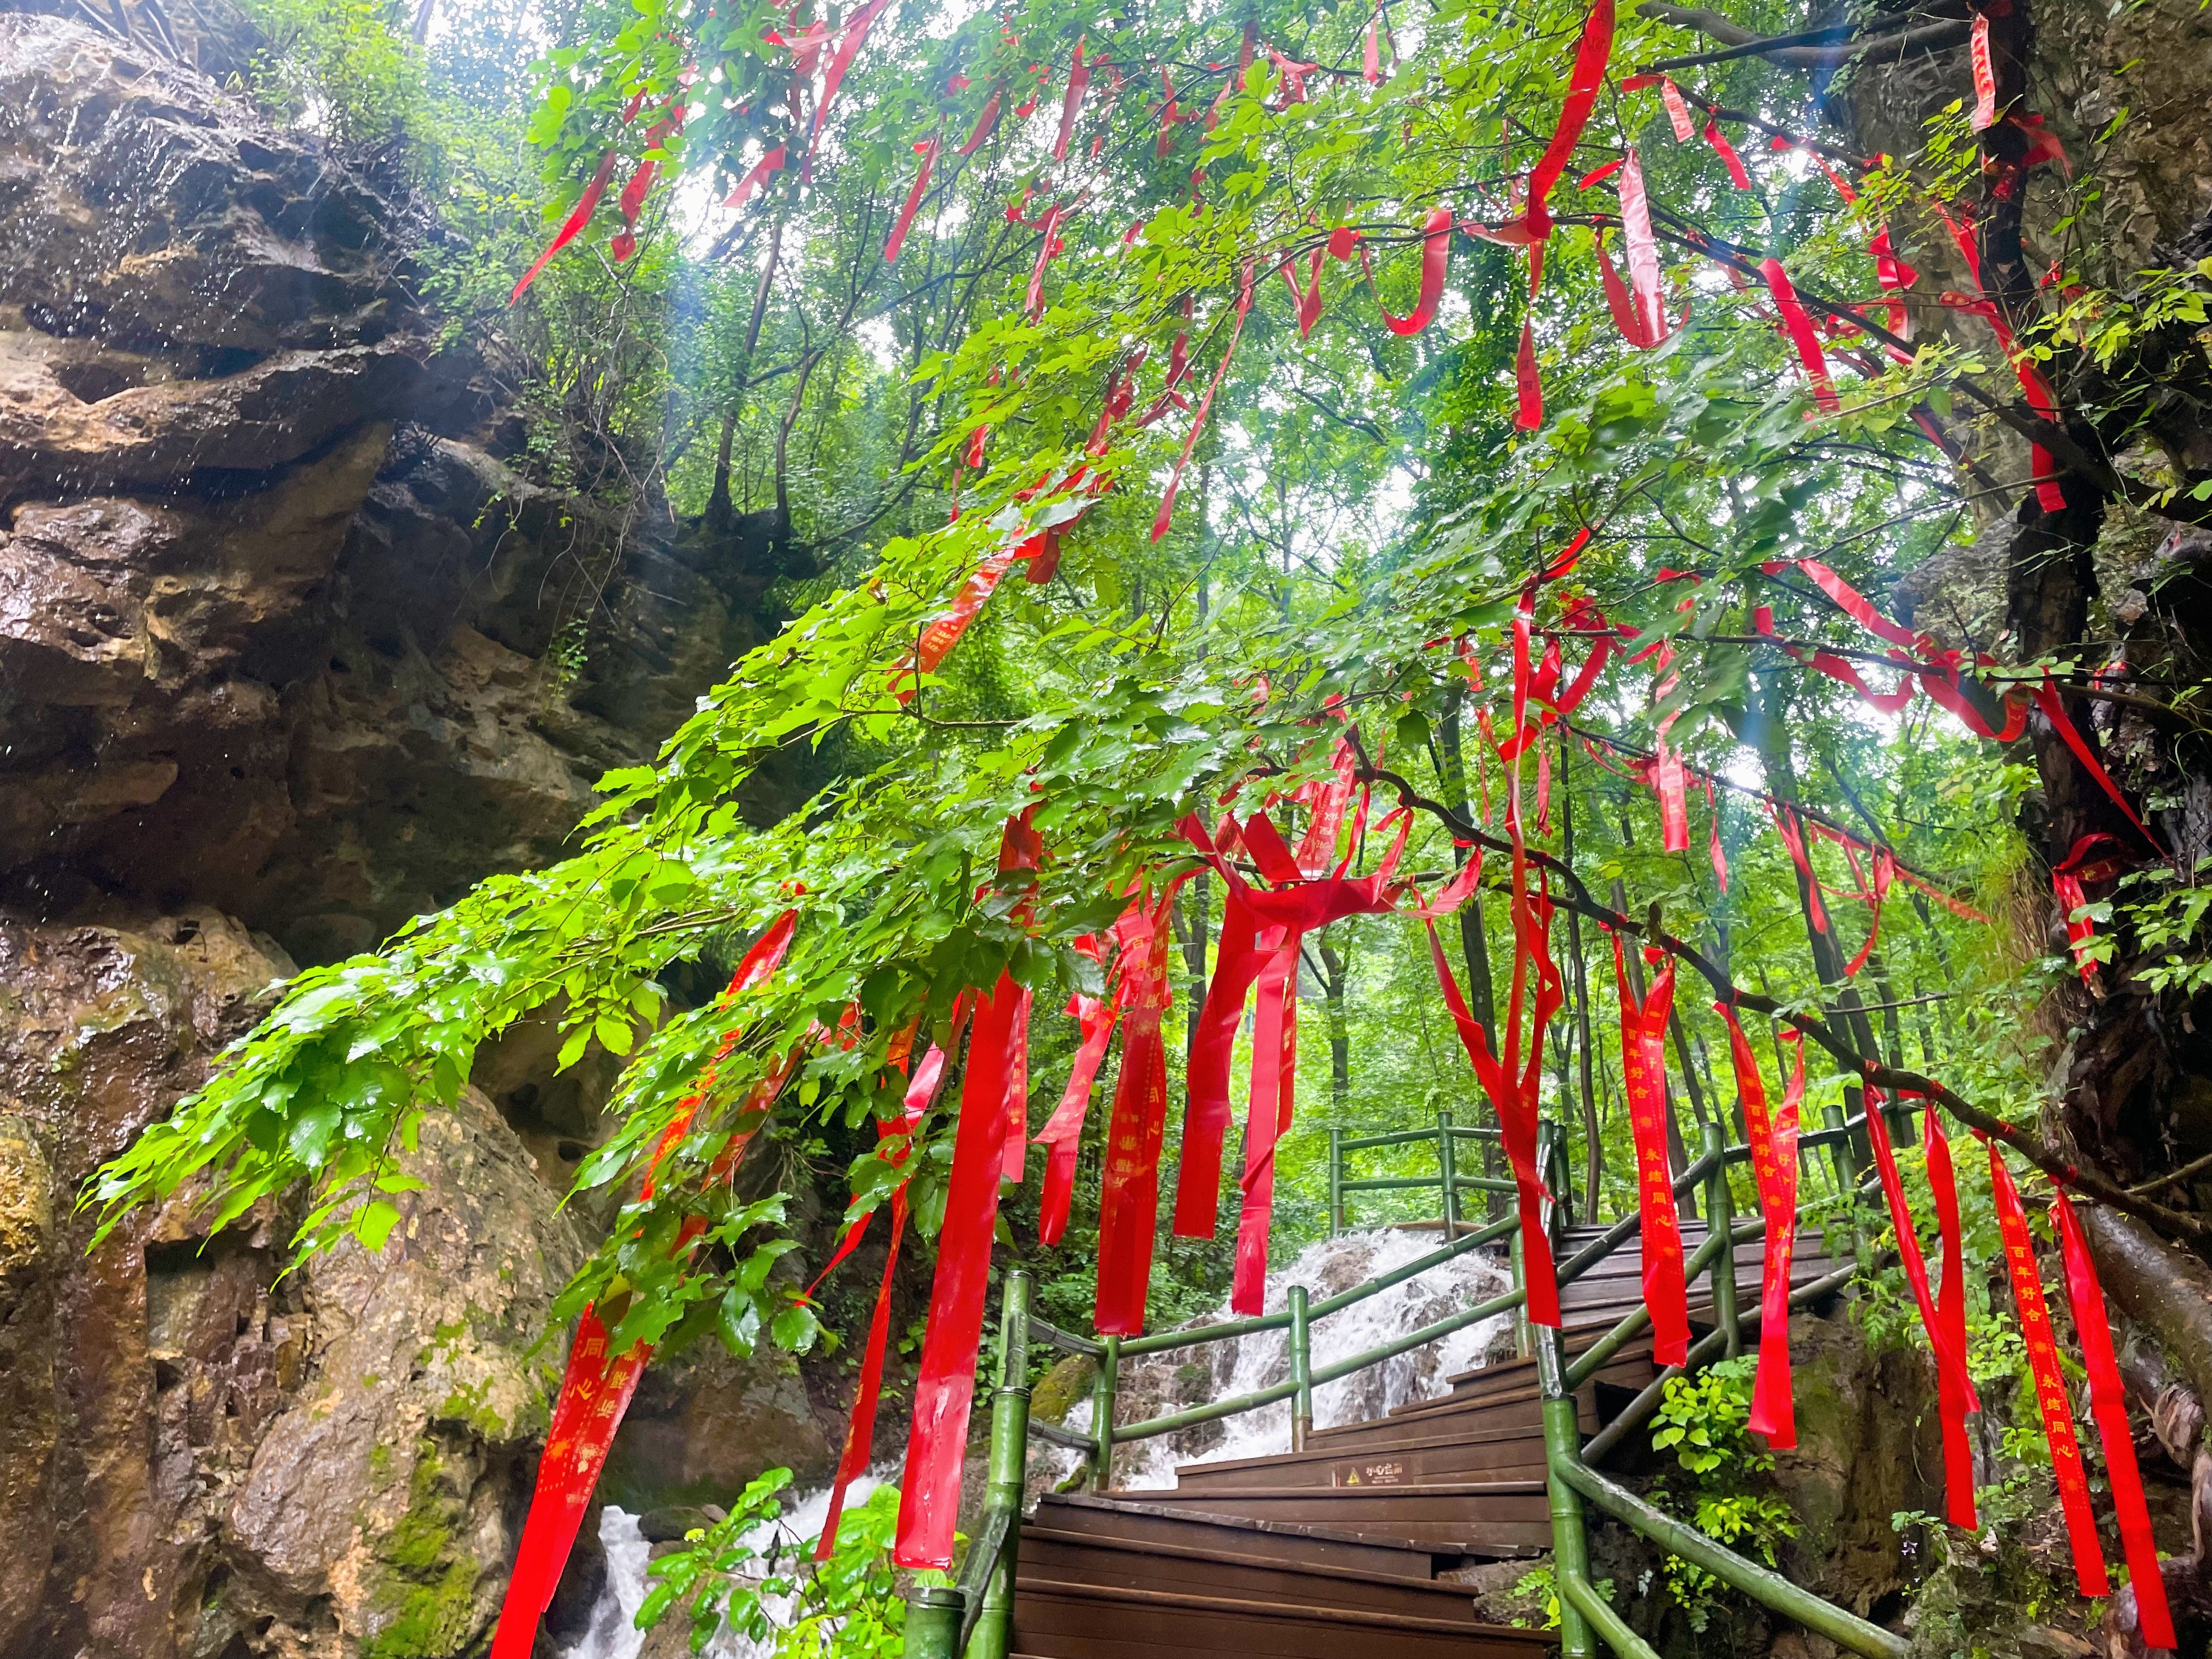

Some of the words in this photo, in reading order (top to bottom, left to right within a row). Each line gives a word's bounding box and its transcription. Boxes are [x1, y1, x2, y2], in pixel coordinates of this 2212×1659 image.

[1627, 1028, 1649, 1099] 百年好合
[1645, 1148, 1672, 1227] 永结同心
[1748, 1104, 1776, 1178] 百年好合
[2010, 1246, 2041, 1322] 百年好合
[2042, 1374, 2073, 1458] 永结同心
